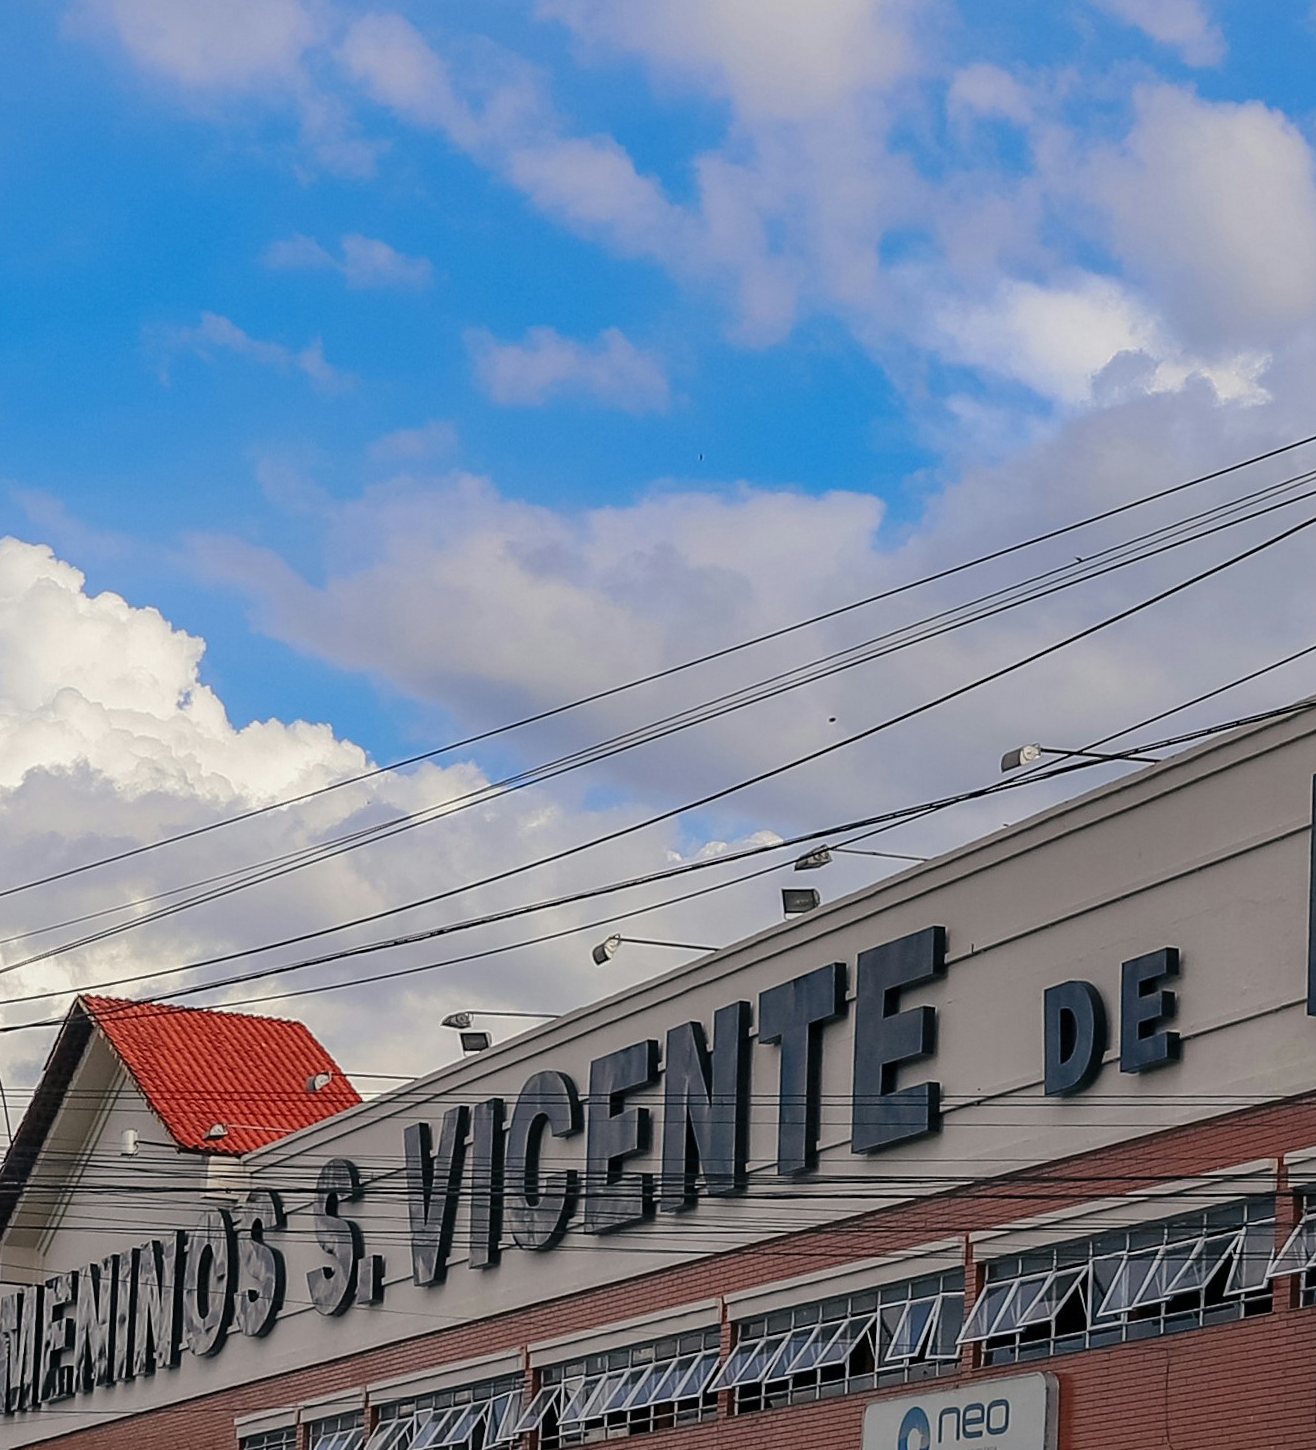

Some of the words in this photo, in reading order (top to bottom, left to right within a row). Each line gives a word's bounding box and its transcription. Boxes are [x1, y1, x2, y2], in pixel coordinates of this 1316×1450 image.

[306, 1157, 385, 1317] S.
[403, 924, 947, 1287] VICENTE
[1043, 947, 1181, 1097] DE
[937, 1397, 1011, 1444] neo
